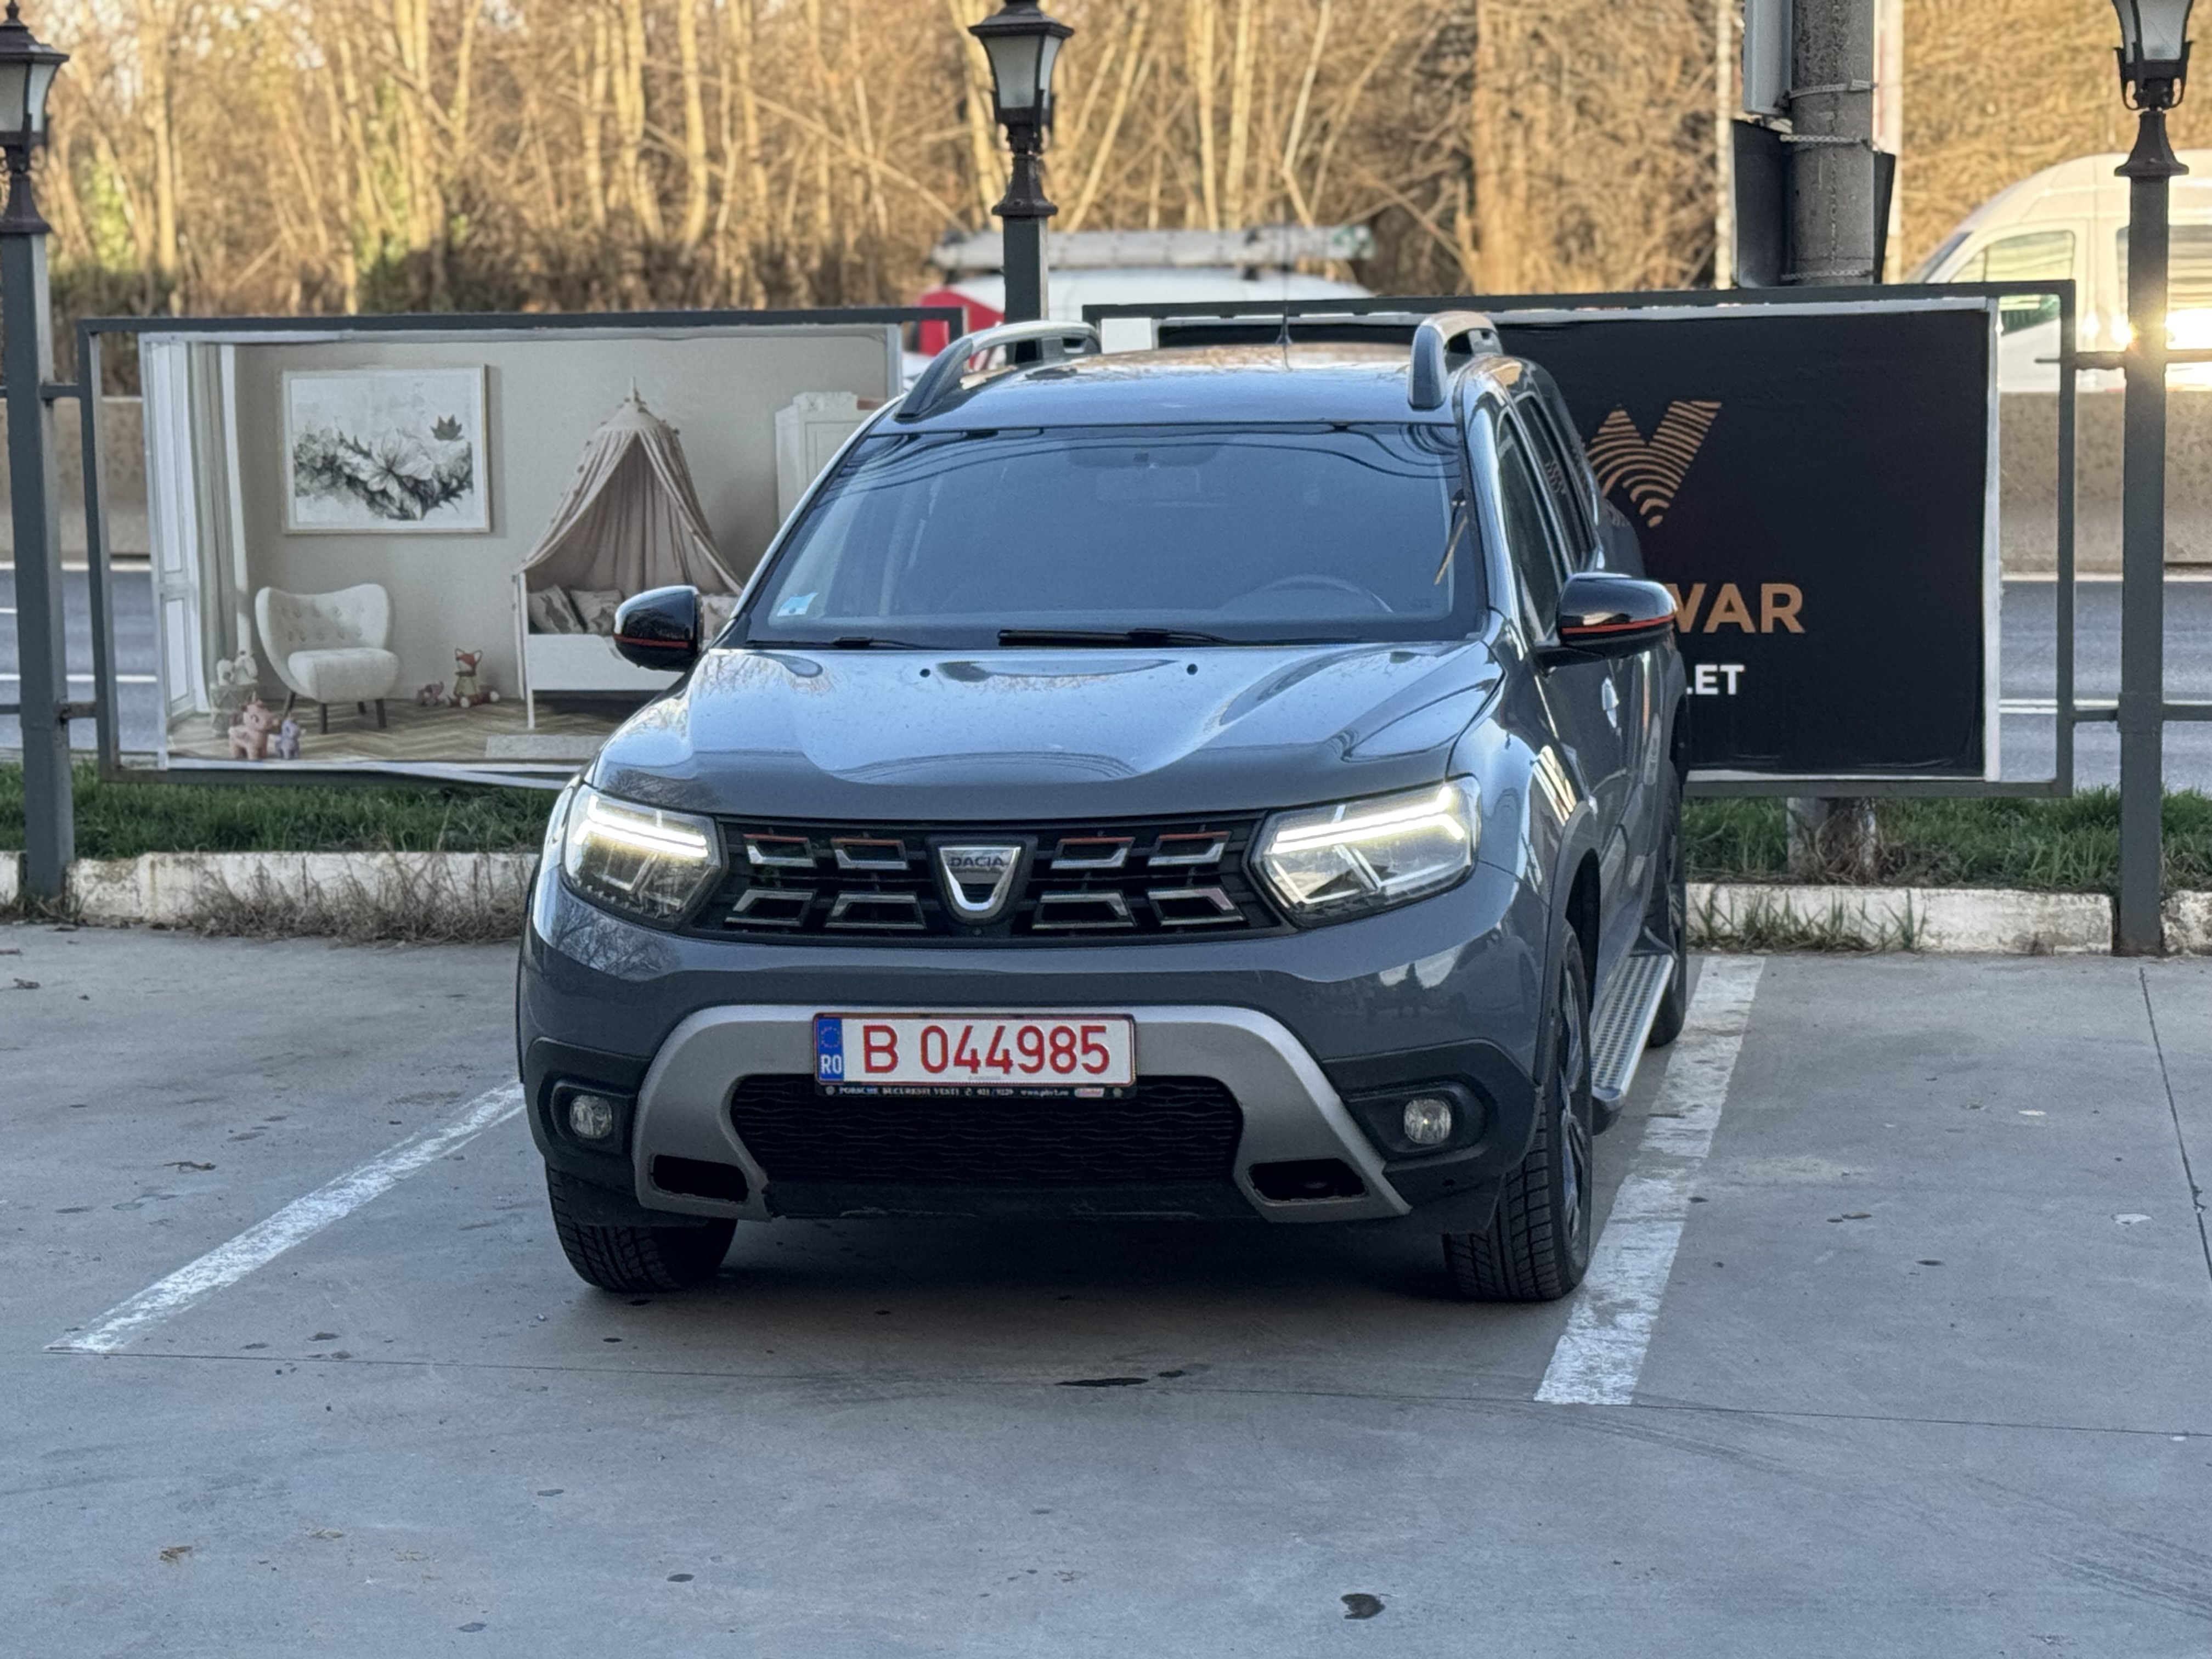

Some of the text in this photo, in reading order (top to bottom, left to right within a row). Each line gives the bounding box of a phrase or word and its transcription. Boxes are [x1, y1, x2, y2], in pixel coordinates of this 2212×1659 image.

[1686, 664, 1745, 695] ET
[950, 856, 1005, 867] DACIA
[862, 1025, 1110, 1074] B 044985
[821, 1054, 842, 1074] RO
